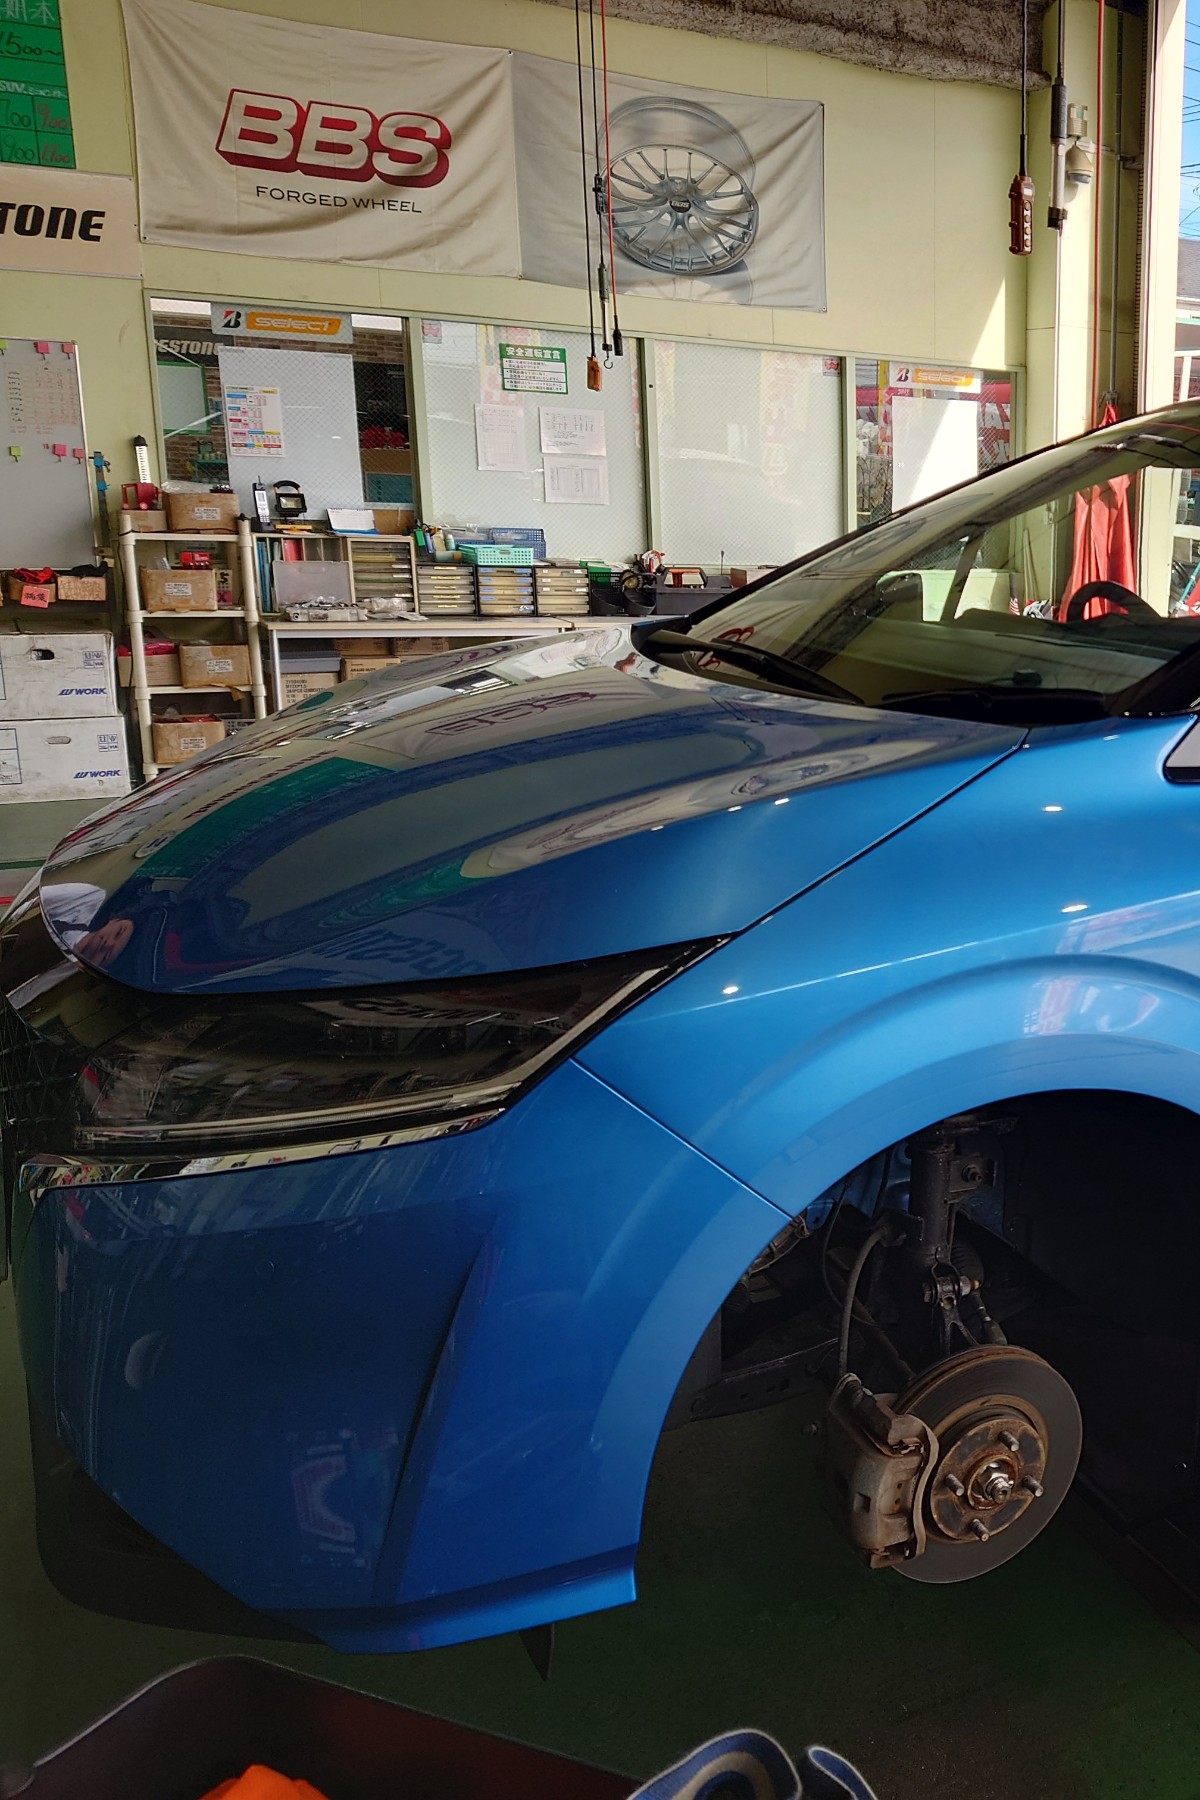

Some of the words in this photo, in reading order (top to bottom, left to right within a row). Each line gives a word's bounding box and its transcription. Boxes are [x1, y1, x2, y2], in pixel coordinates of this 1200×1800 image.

[216, 88, 452, 189] BBS
[256, 186, 348, 209] FORGED
[352, 197, 422, 214] WHEEL
[255, 317, 331, 332] select
[917, 370, 971, 383] select
[75, 687, 107, 696] WORK
[90, 769, 121, 778] WORK
